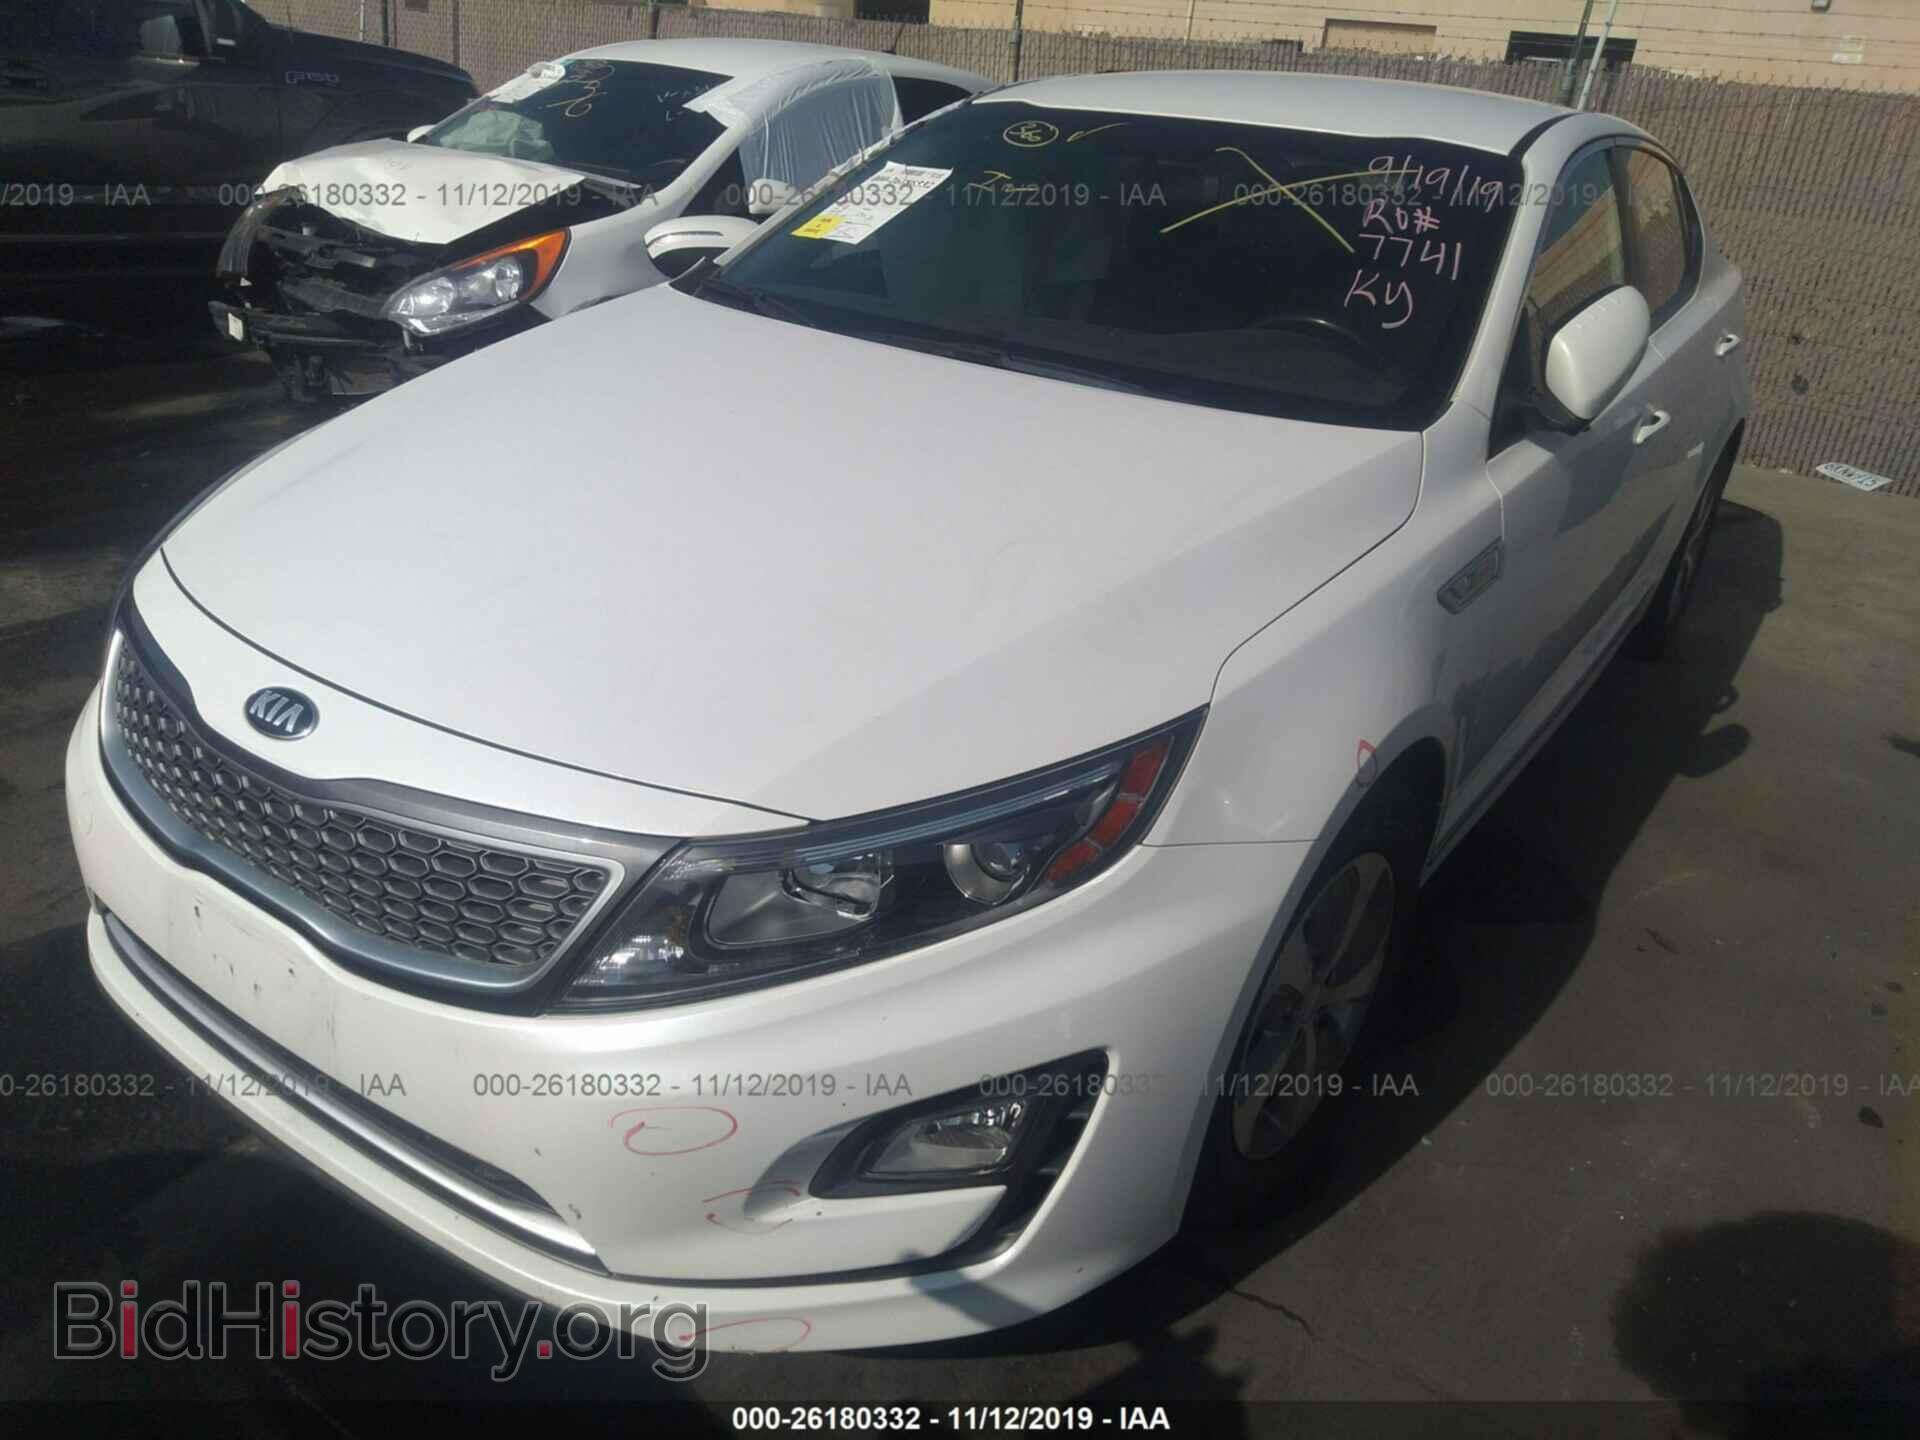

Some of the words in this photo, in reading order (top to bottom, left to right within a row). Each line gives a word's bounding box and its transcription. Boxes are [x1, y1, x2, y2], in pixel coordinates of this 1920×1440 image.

[1368, 155, 1503, 213] 9/19/19
[1359, 233, 1462, 280] 7741
[249, 690, 304, 733] KIA
